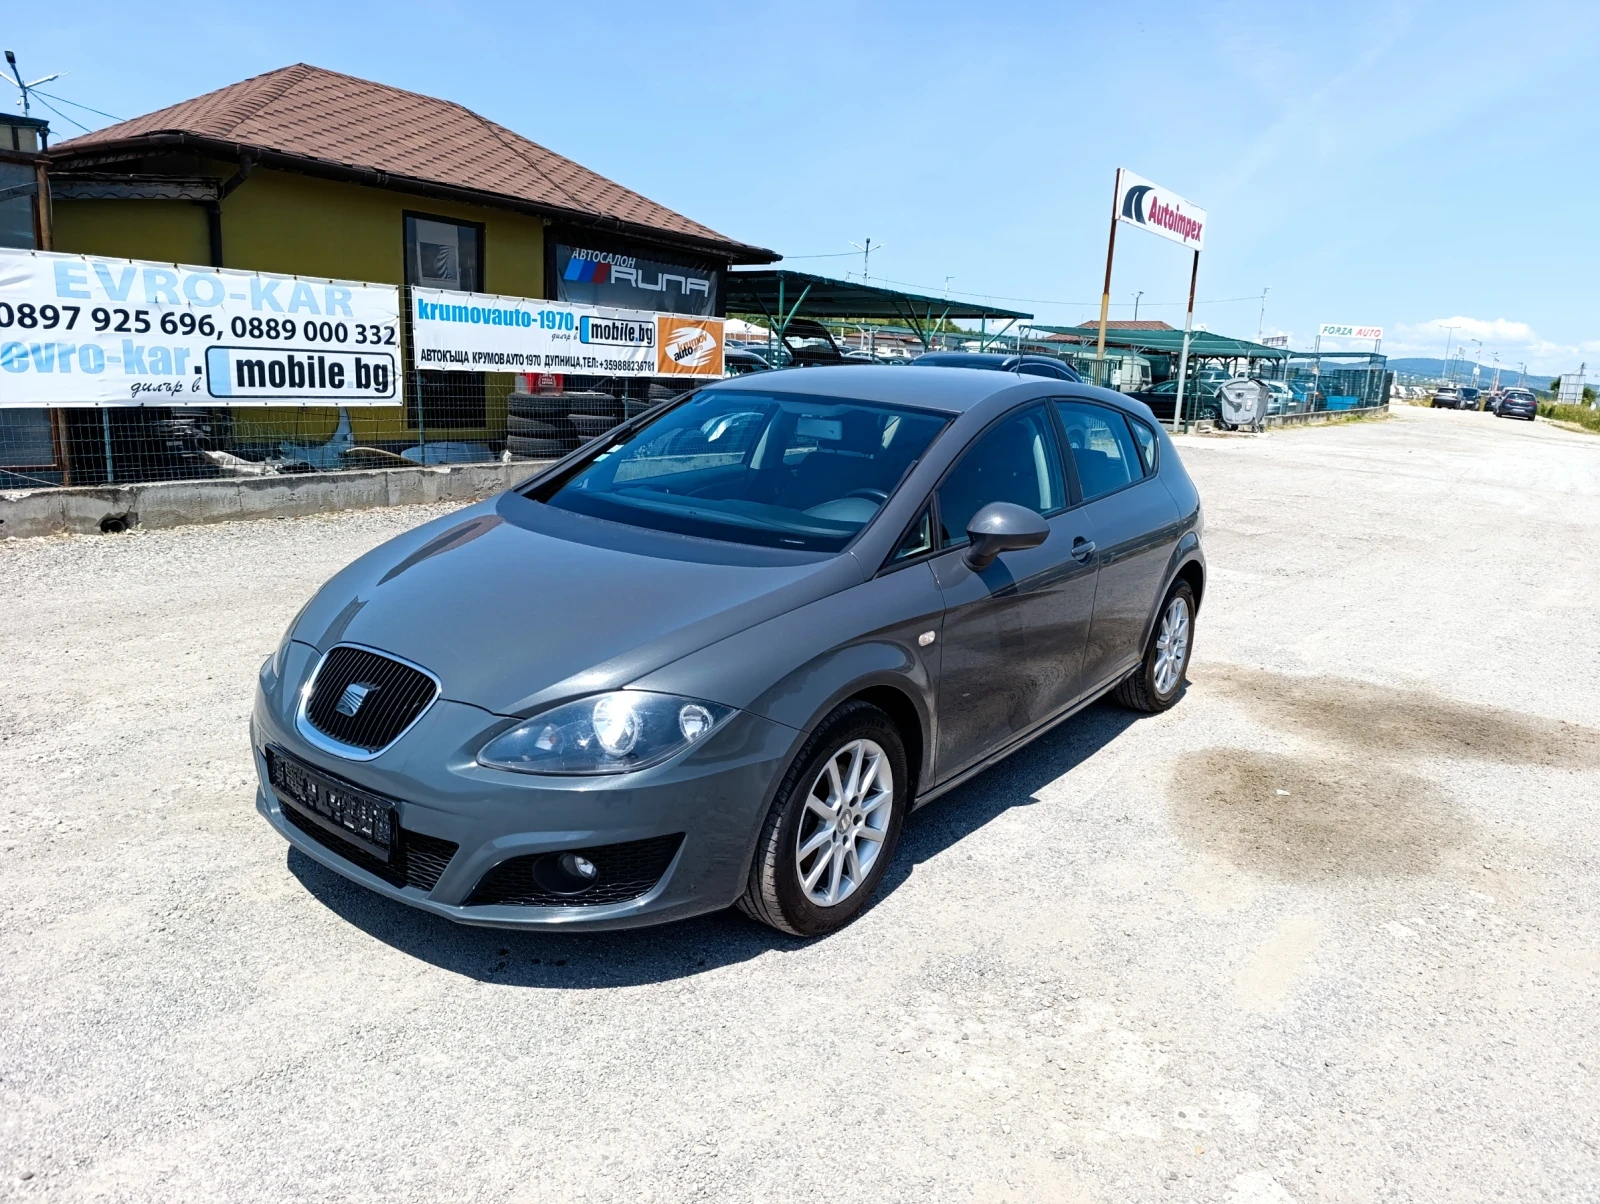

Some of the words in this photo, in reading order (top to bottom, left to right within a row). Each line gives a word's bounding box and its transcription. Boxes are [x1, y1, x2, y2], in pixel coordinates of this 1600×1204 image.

[1148, 195, 1203, 243] Autoimpex
[571, 247, 637, 269] АВТОСАЛОН
[53, 260, 354, 318] EVRO-KAR
[611, 265, 710, 298] RUNA
[0, 302, 81, 331] 0897
[91, 307, 151, 334] 925
[160, 311, 224, 341] 696,
[231, 315, 296, 341] 0889
[303, 320, 349, 344] 000
[355, 323, 397, 346] 332
[590, 322, 653, 345] mobile.bg
[1321, 326, 1353, 336] FORZA
[1355, 328, 1382, 338] AUTO
[677, 332, 708, 352] krumov
[420, 348, 470, 366] АВТОКЪЩА
[472, 351, 505, 365] КРУМОВ
[505, 353, 525, 366] АУТО
[525, 354, 542, 367] 1970
[673, 346, 694, 362] auto
[235, 354, 390, 394] mobile.bg
[130, 379, 184, 399] дилър
[191, 376, 203, 393] в
